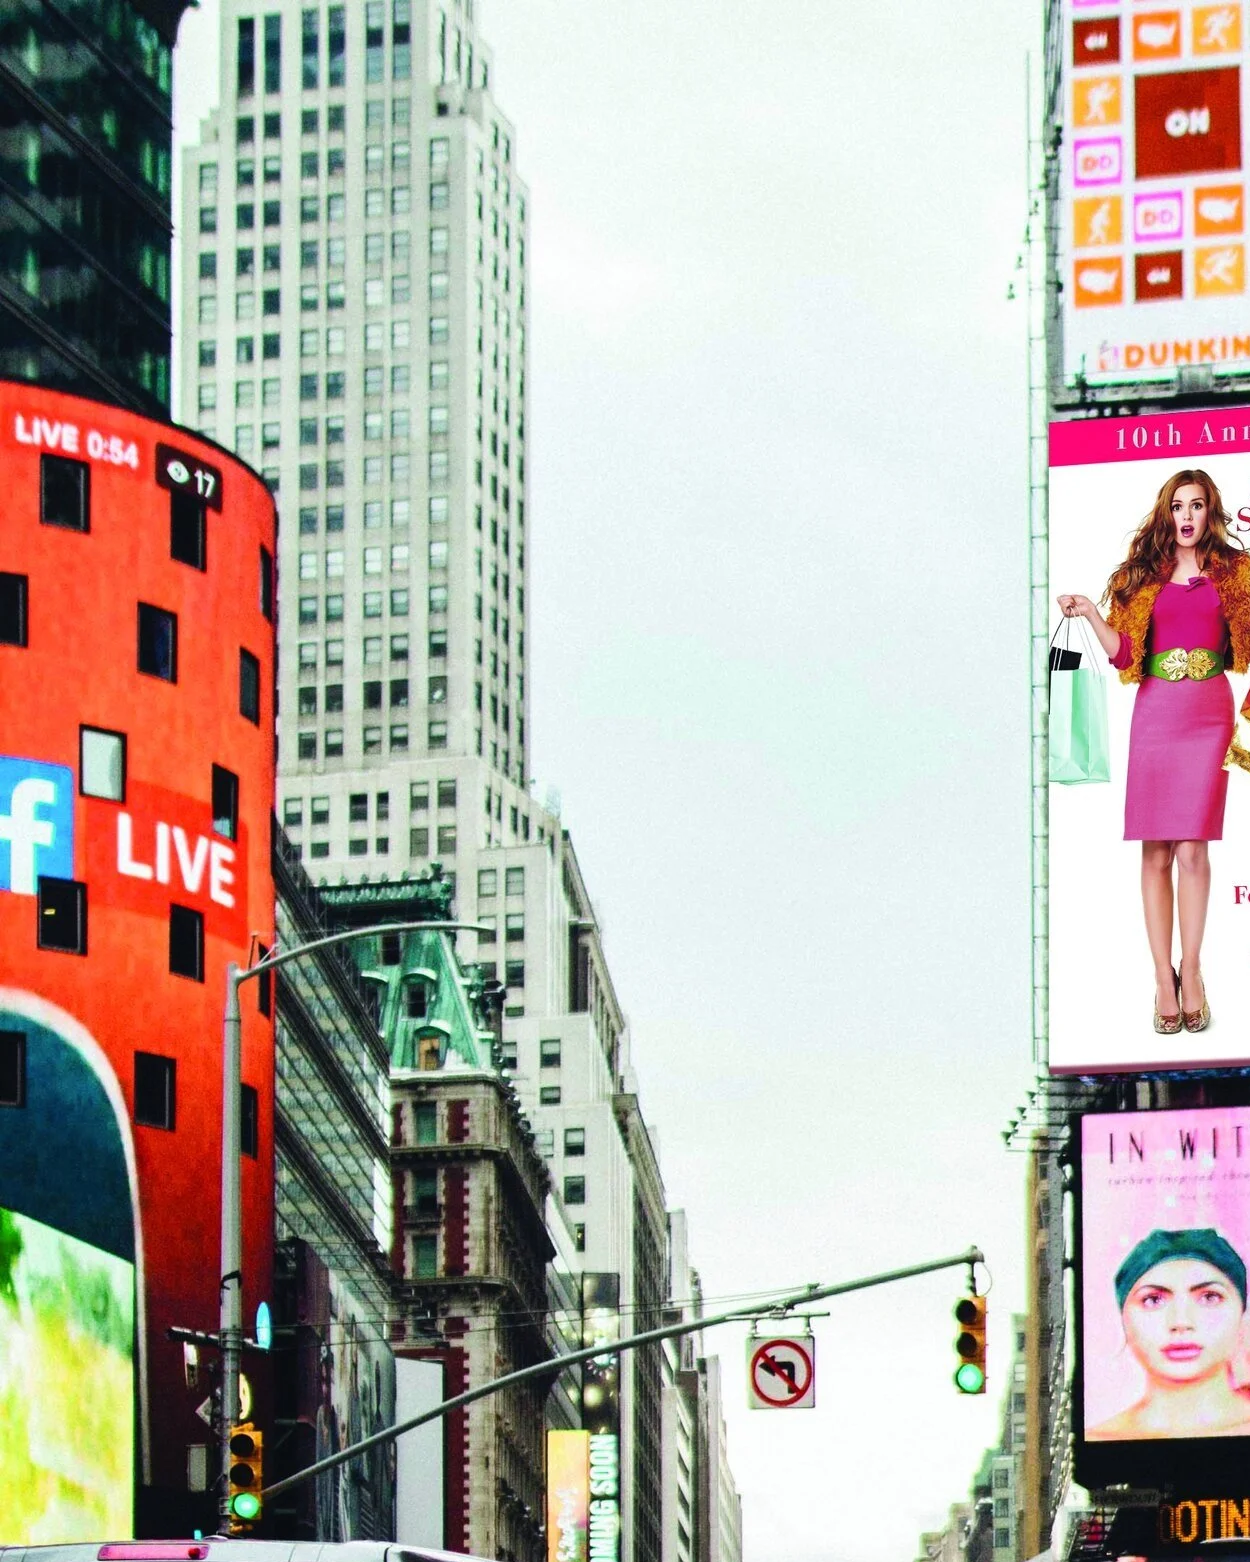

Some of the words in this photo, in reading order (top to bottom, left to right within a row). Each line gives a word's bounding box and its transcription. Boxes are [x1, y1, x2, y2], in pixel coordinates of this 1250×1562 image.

[15, 413, 79, 453] LIVE
[87, 430, 140, 469] 0:54
[1116, 421, 1182, 451] 10th
[193, 468, 216, 499] 17
[116, 810, 236, 908] LIVE
[1109, 1131, 1145, 1165] IN
[589, 1434, 619, 1496] SOON
